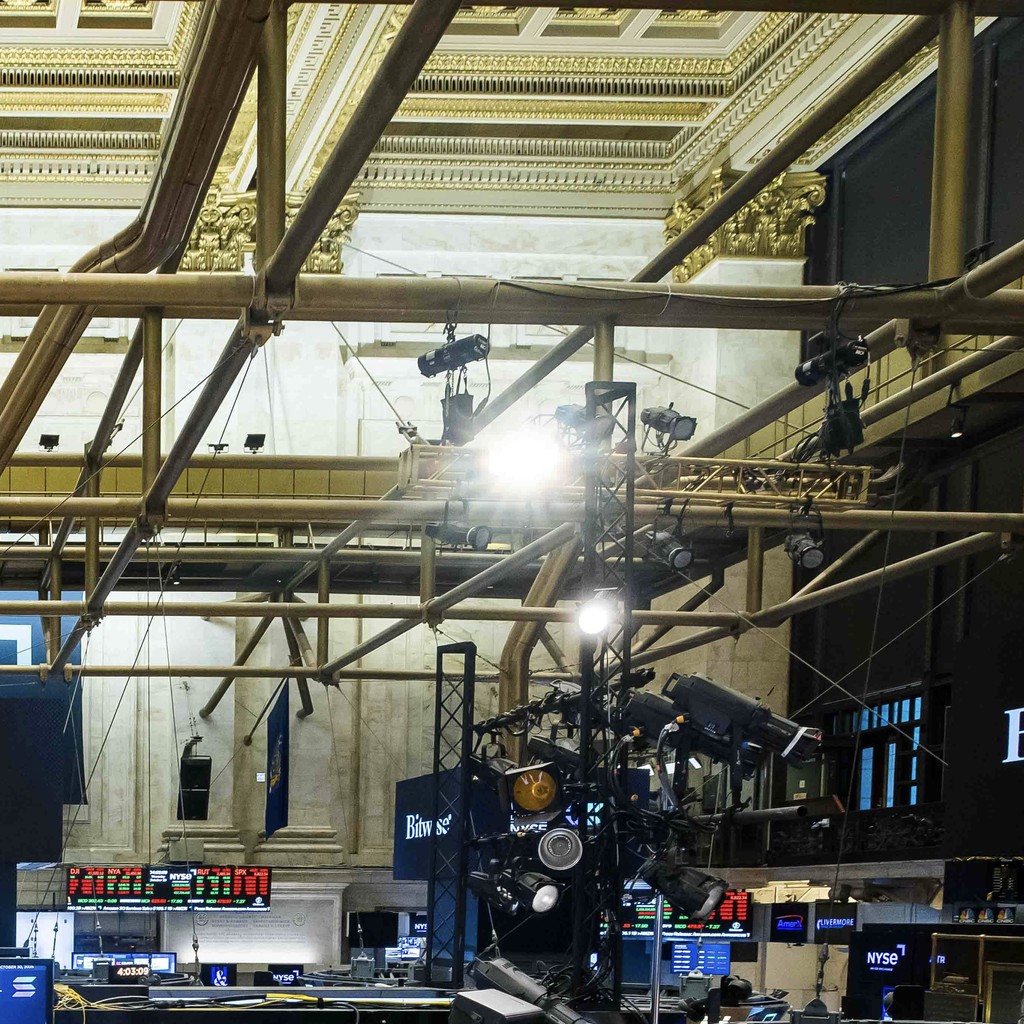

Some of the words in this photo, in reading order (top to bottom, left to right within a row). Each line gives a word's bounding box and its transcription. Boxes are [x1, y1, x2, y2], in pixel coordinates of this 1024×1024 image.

[406, 814, 451, 840] Bitwse
[820, 918, 854, 926] LIVERMORE
[116, 967, 149, 977] 4:03:09
